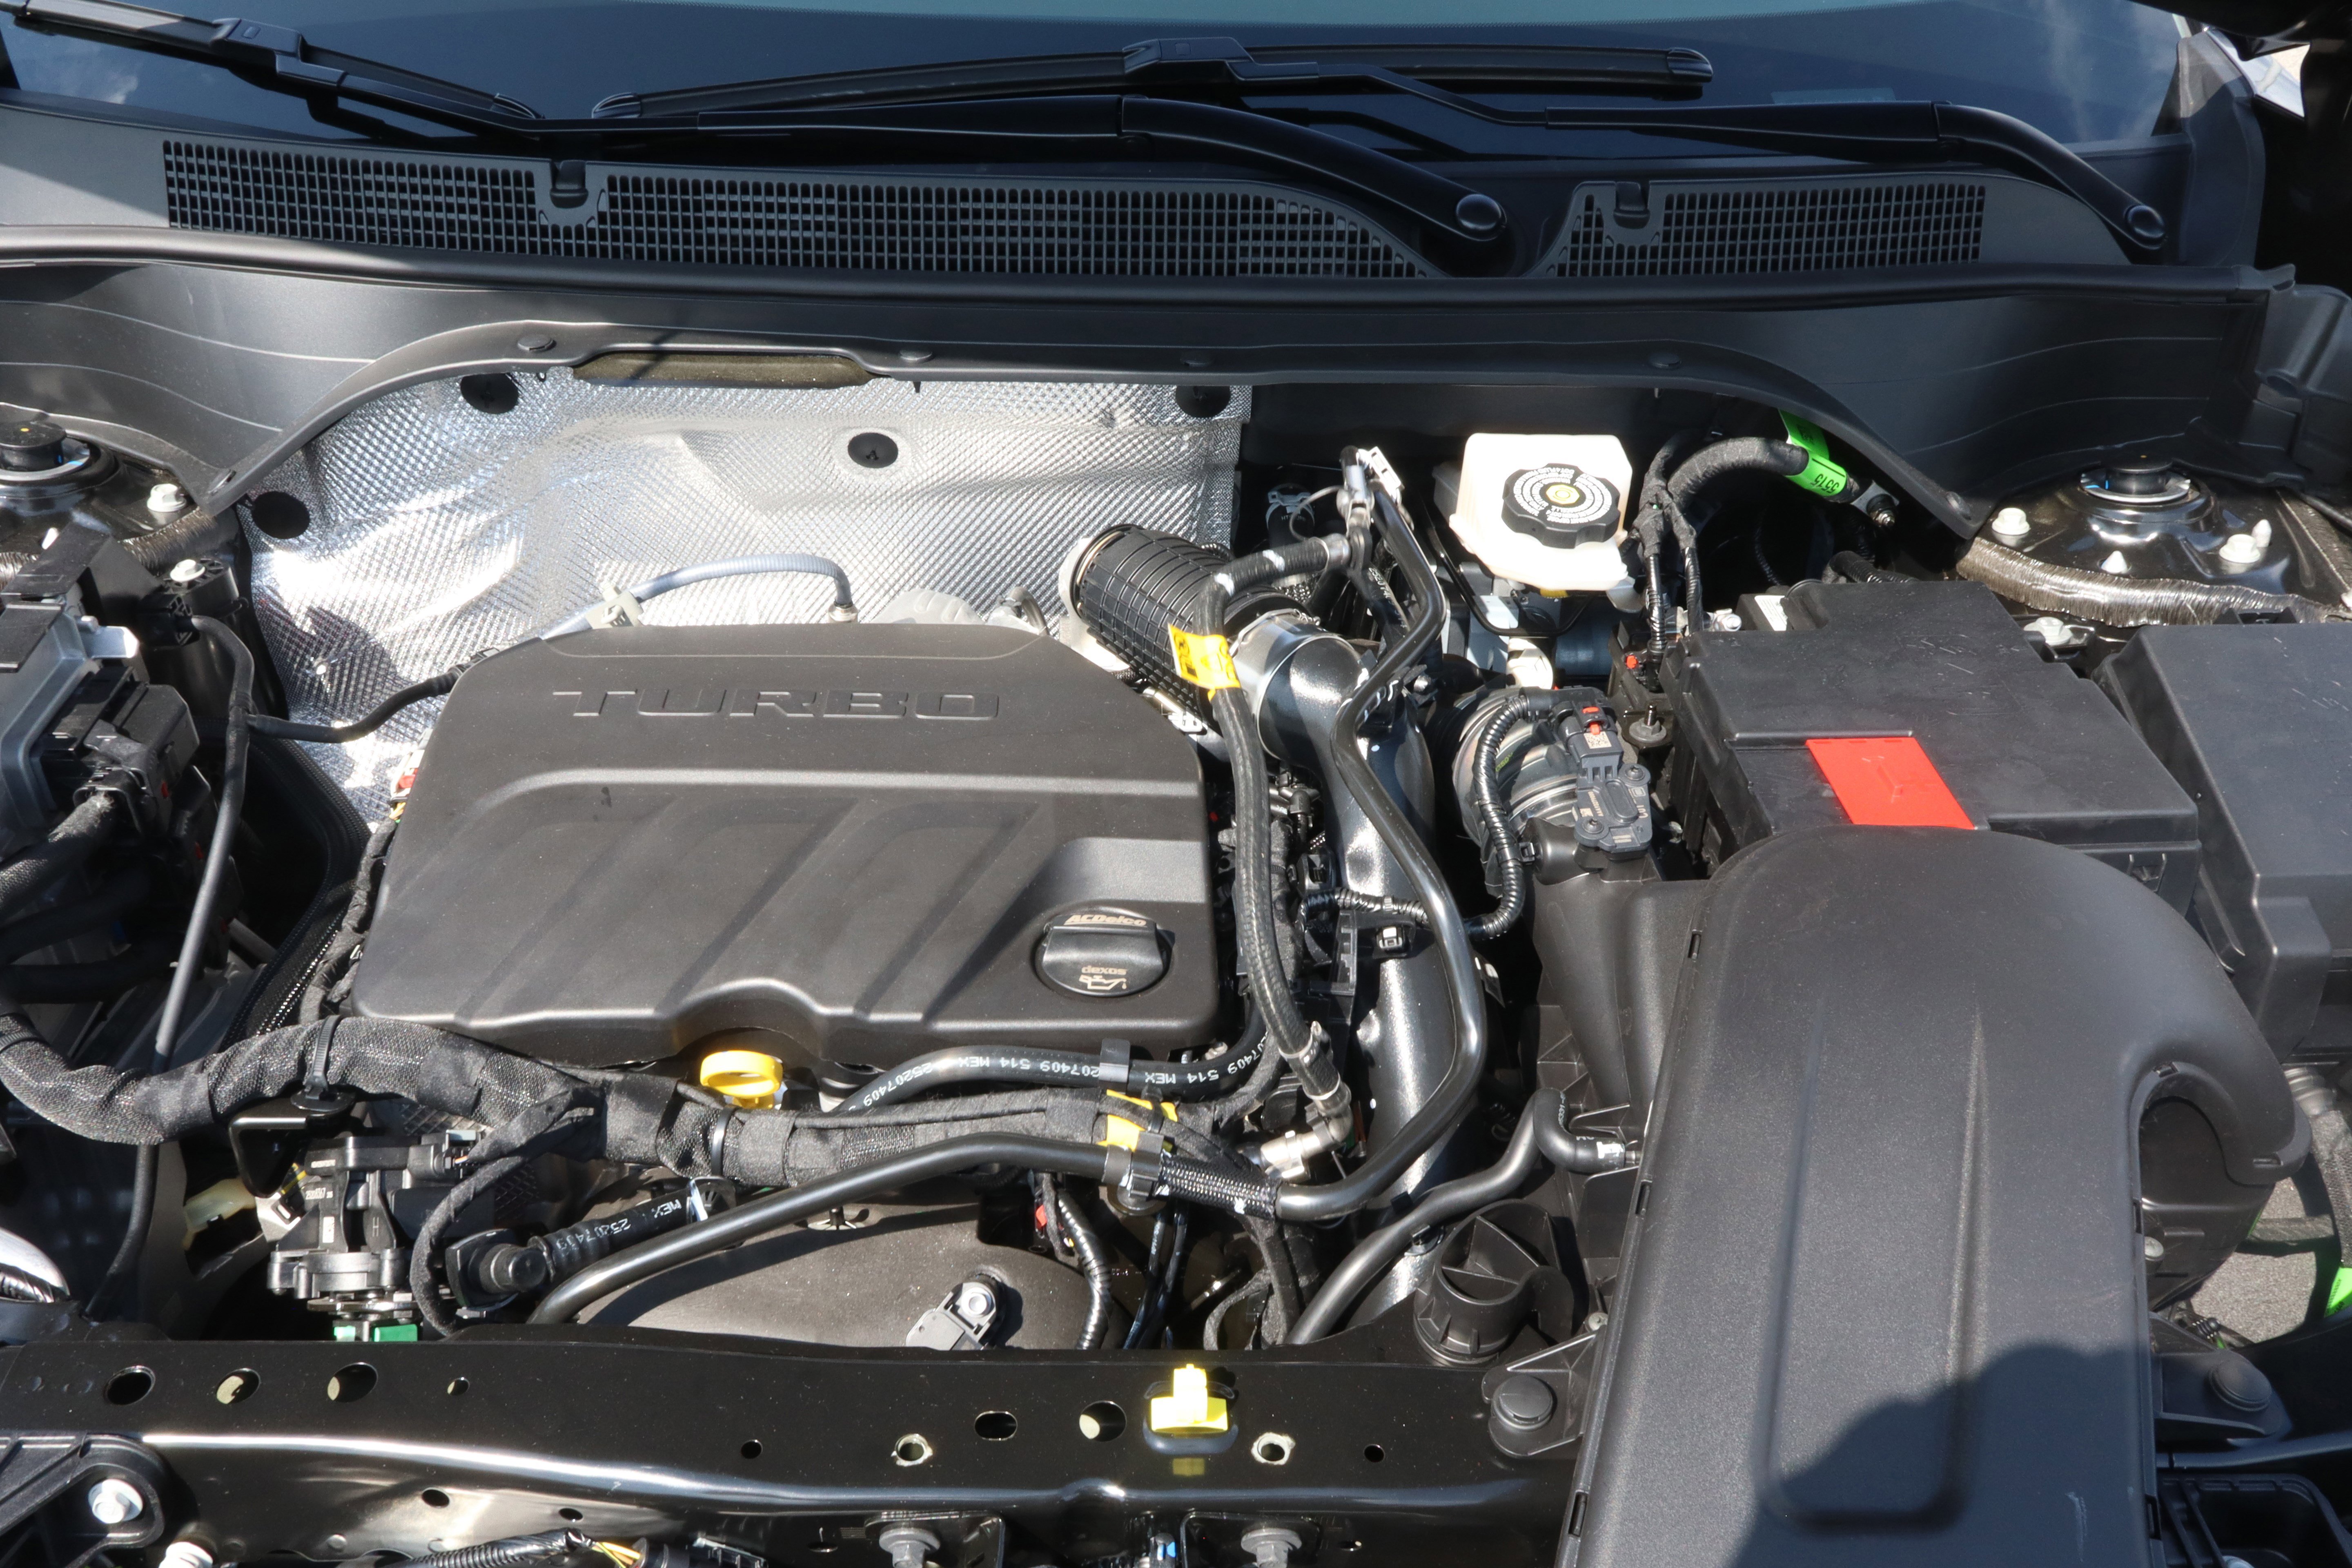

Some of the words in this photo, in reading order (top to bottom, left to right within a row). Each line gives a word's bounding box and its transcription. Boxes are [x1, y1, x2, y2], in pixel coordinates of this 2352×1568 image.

[1810, 474, 1839, 493] 5515
[552, 689, 999, 720] TURBO
[1064, 914, 1147, 927] ACDelco
[1081, 965, 1127, 975] dexos
[959, 1056, 990, 1068] MEX
[1000, 1057, 1032, 1070] 514
[1040, 1061, 1100, 1077] 207409
[1145, 1071, 1176, 1085] MEX
[1187, 1069, 1219, 1084] 514
[862, 1062, 933, 1107] 25207409
[651, 1199, 682, 1218] MEX
